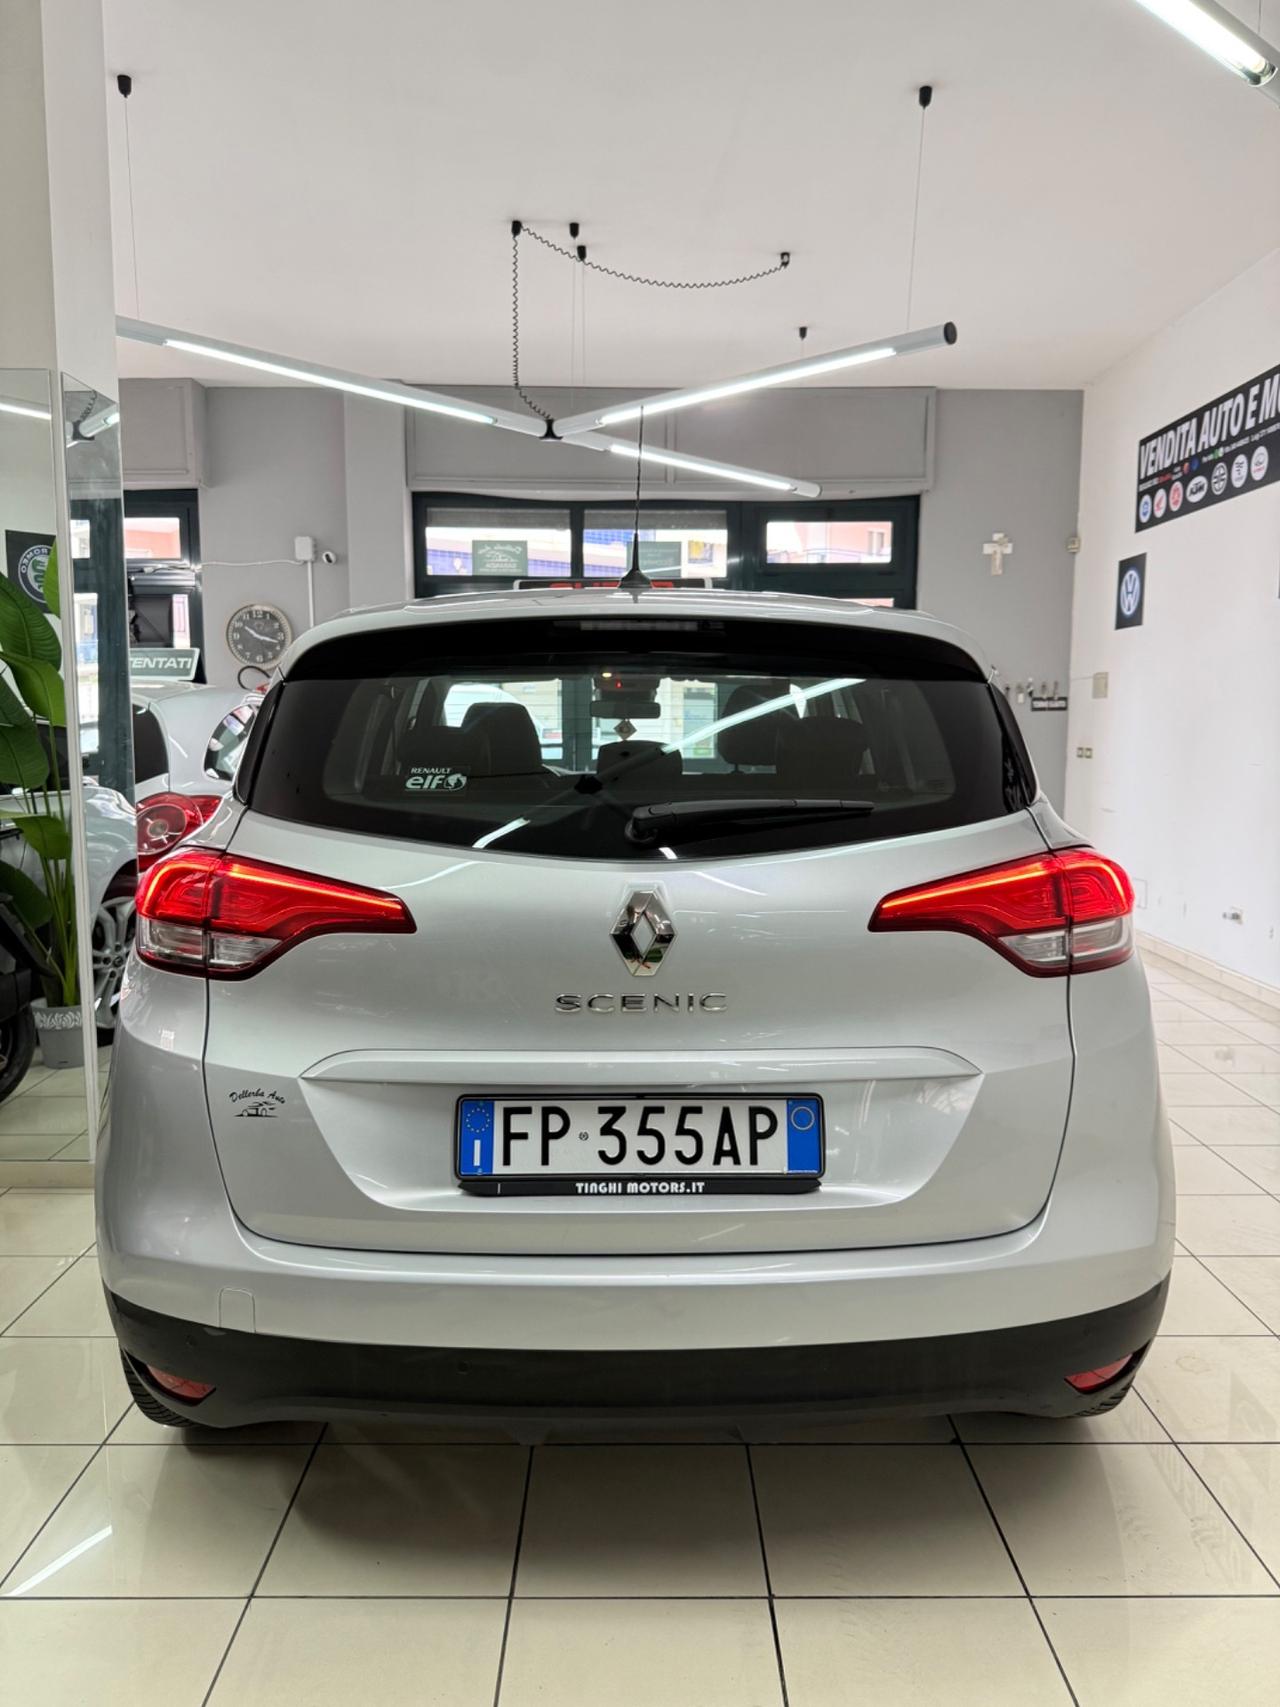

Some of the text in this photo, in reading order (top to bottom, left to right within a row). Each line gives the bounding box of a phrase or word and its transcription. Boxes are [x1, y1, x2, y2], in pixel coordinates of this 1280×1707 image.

[1140, 418, 1198, 479] VENDITA
[1197, 393, 1245, 453] AUTO
[1245, 383, 1260, 430] E
[405, 775, 446, 789] elf
[556, 993, 728, 1013] SCENIC
[502, 1106, 779, 1166] FP 355AP
[575, 1181, 705, 1194] TINGHI MOTORS.IT
